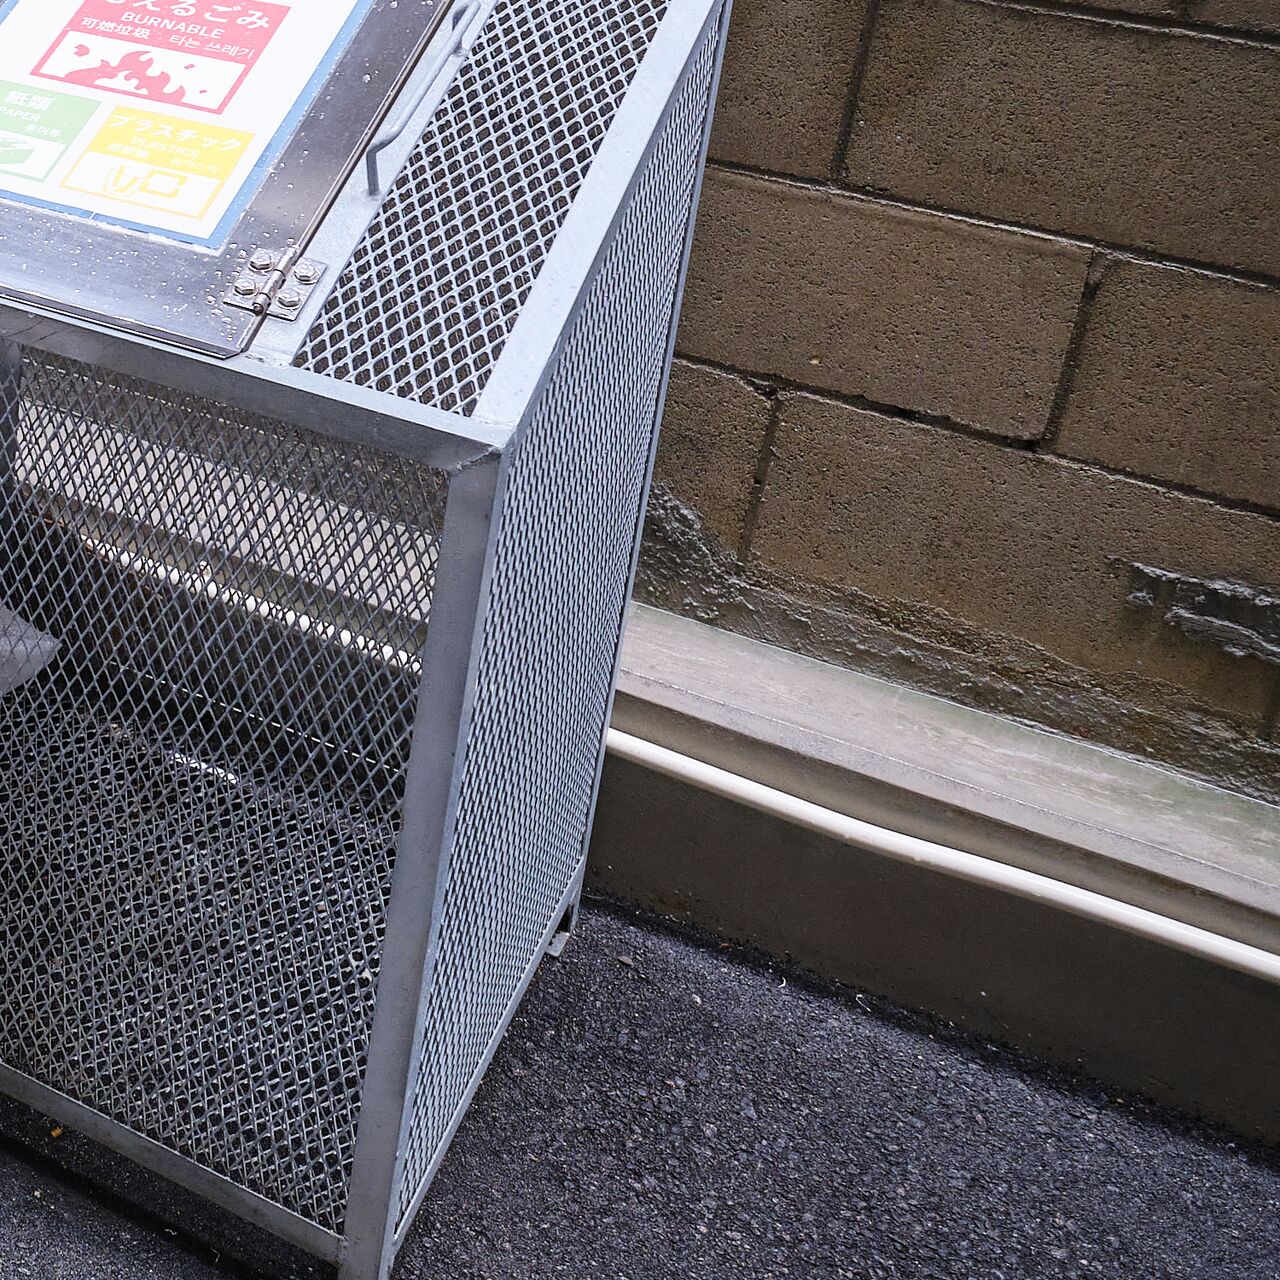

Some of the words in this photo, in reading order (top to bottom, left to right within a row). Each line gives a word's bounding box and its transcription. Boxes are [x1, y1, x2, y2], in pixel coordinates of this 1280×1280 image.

[121, 12, 225, 39] BURNABLE
[170, 34, 201, 49] 타는
[109, 113, 242, 152] プラスチック
